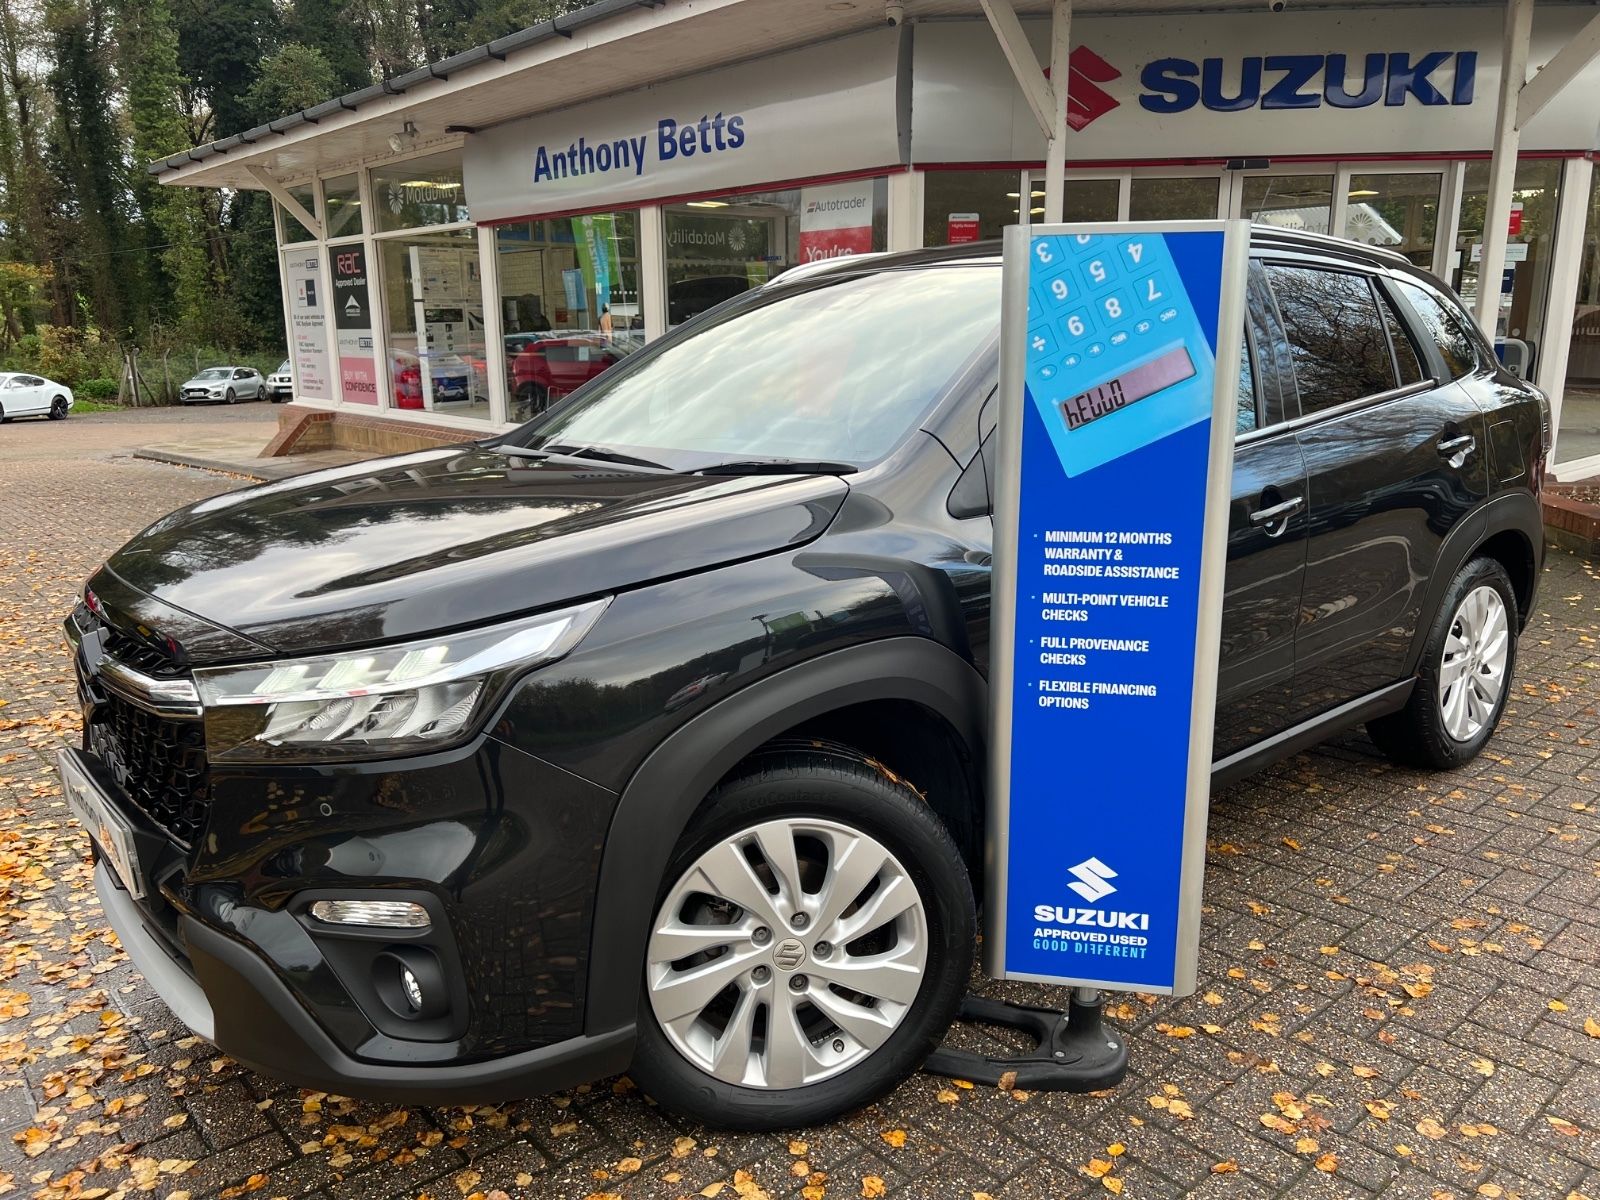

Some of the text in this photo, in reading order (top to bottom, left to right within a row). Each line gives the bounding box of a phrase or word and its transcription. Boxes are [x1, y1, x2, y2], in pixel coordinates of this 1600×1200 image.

[1138, 50, 1478, 114] SUZUKI
[534, 112, 745, 183] Anthony Betts
[406, 175, 458, 205] Motability
[814, 197, 866, 213] Autotrader
[806, 244, 853, 264] You're
[1036, 242, 1053, 263] 3
[1127, 243, 1143, 264] 4
[336, 252, 361, 275] RAC
[1089, 260, 1106, 283] 5
[335, 277, 366, 288] Approved Dealer
[1147, 279, 1162, 301] 7
[1105, 297, 1122, 319] 8
[354, 370, 368, 381] WITH
[345, 381, 376, 393] CONFIDENCE
[1045, 530, 1173, 545] MINIMUM 12 MONTHS
[1044, 547, 1123, 561] WARRANTY &
[1043, 564, 1180, 579] ROADSIDE ASSISTANCE
[1042, 592, 1169, 608] MULTI-POINT VEHICLE
[1041, 609, 1089, 622] CHECKS
[1040, 636, 1150, 652] FULL PROVENANCE
[1039, 652, 1087, 666] CHECKS
[1039, 679, 1157, 697] FLEXIBLE FINANCING
[1038, 695, 1089, 710] OPTIONS
[1033, 904, 1150, 931] SUZUKI
[1033, 927, 1148, 946] APPROVED USED
[1033, 938, 1147, 959] GOOD DIFFERENT
